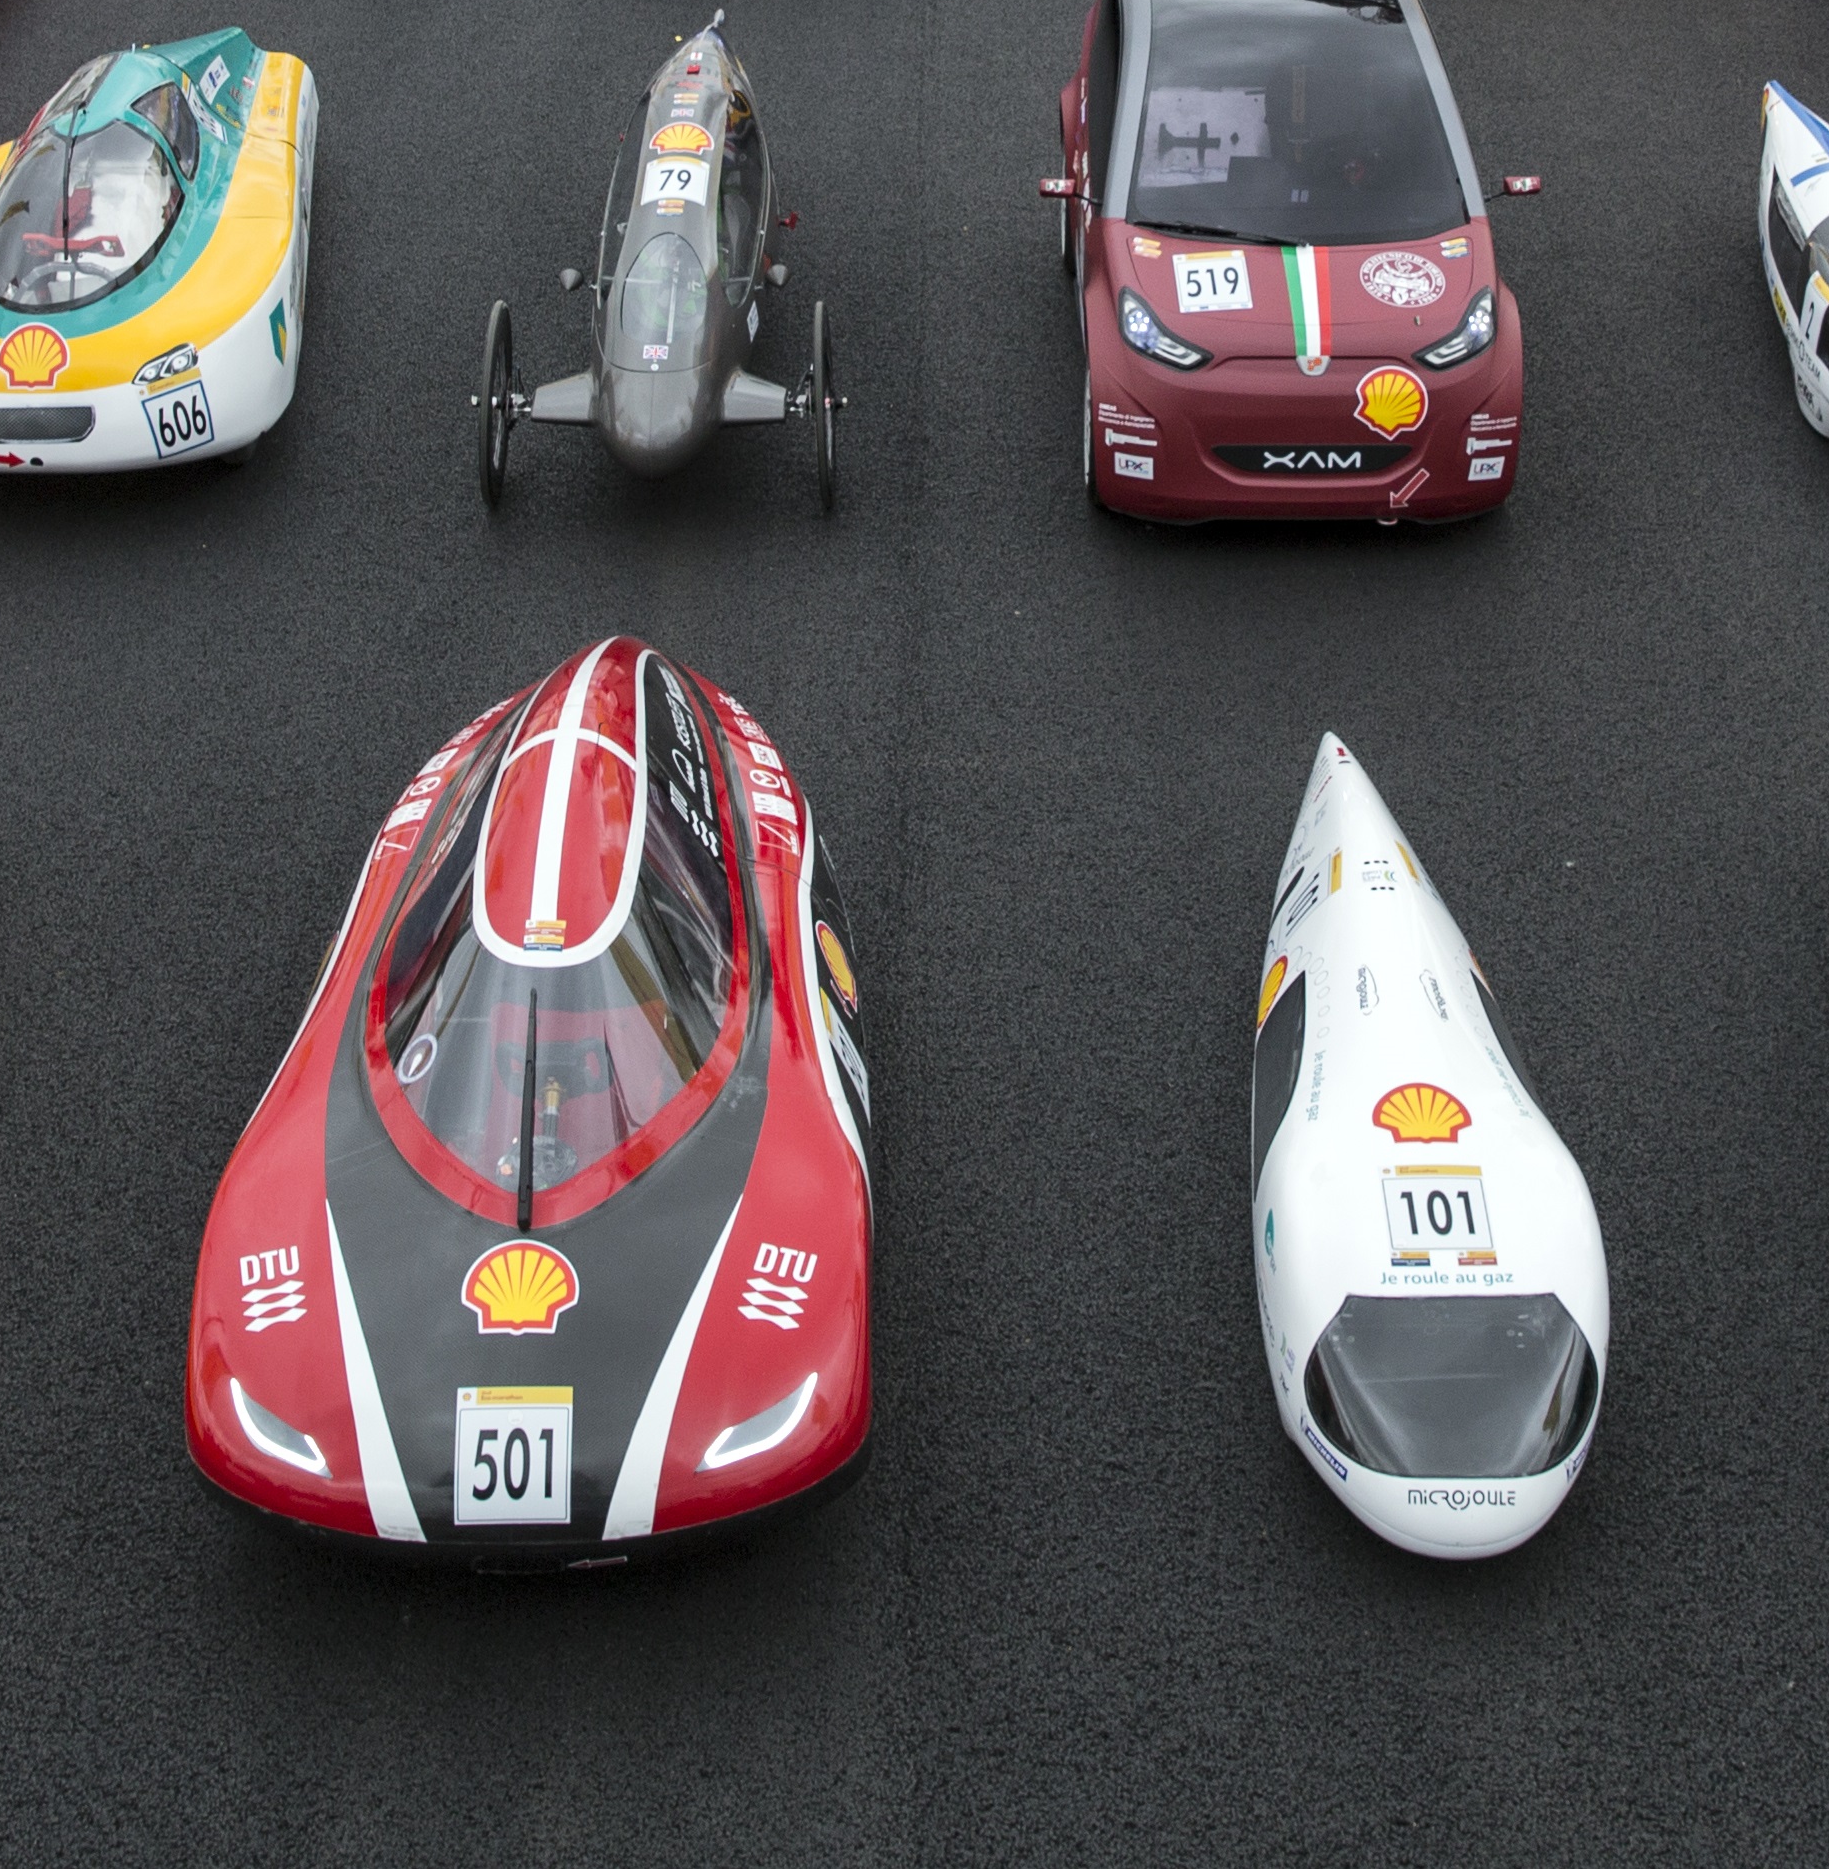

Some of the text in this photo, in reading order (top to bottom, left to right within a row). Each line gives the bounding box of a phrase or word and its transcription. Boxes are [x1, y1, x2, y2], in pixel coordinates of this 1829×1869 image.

[660, 169, 691, 191] 79
[1186, 267, 1239, 297] 519
[1804, 302, 1815, 339] 2
[158, 395, 207, 447] 606
[1263, 451, 1361, 469] XAM
[1400, 1190, 1475, 1235] 101
[239, 1245, 300, 1286] DTU
[753, 1242, 818, 1283] DTU
[1380, 1271, 1514, 1286] Je roule au gaz
[472, 1427, 554, 1501] 501
[1307, 1431, 1346, 1478] MICHELIN
